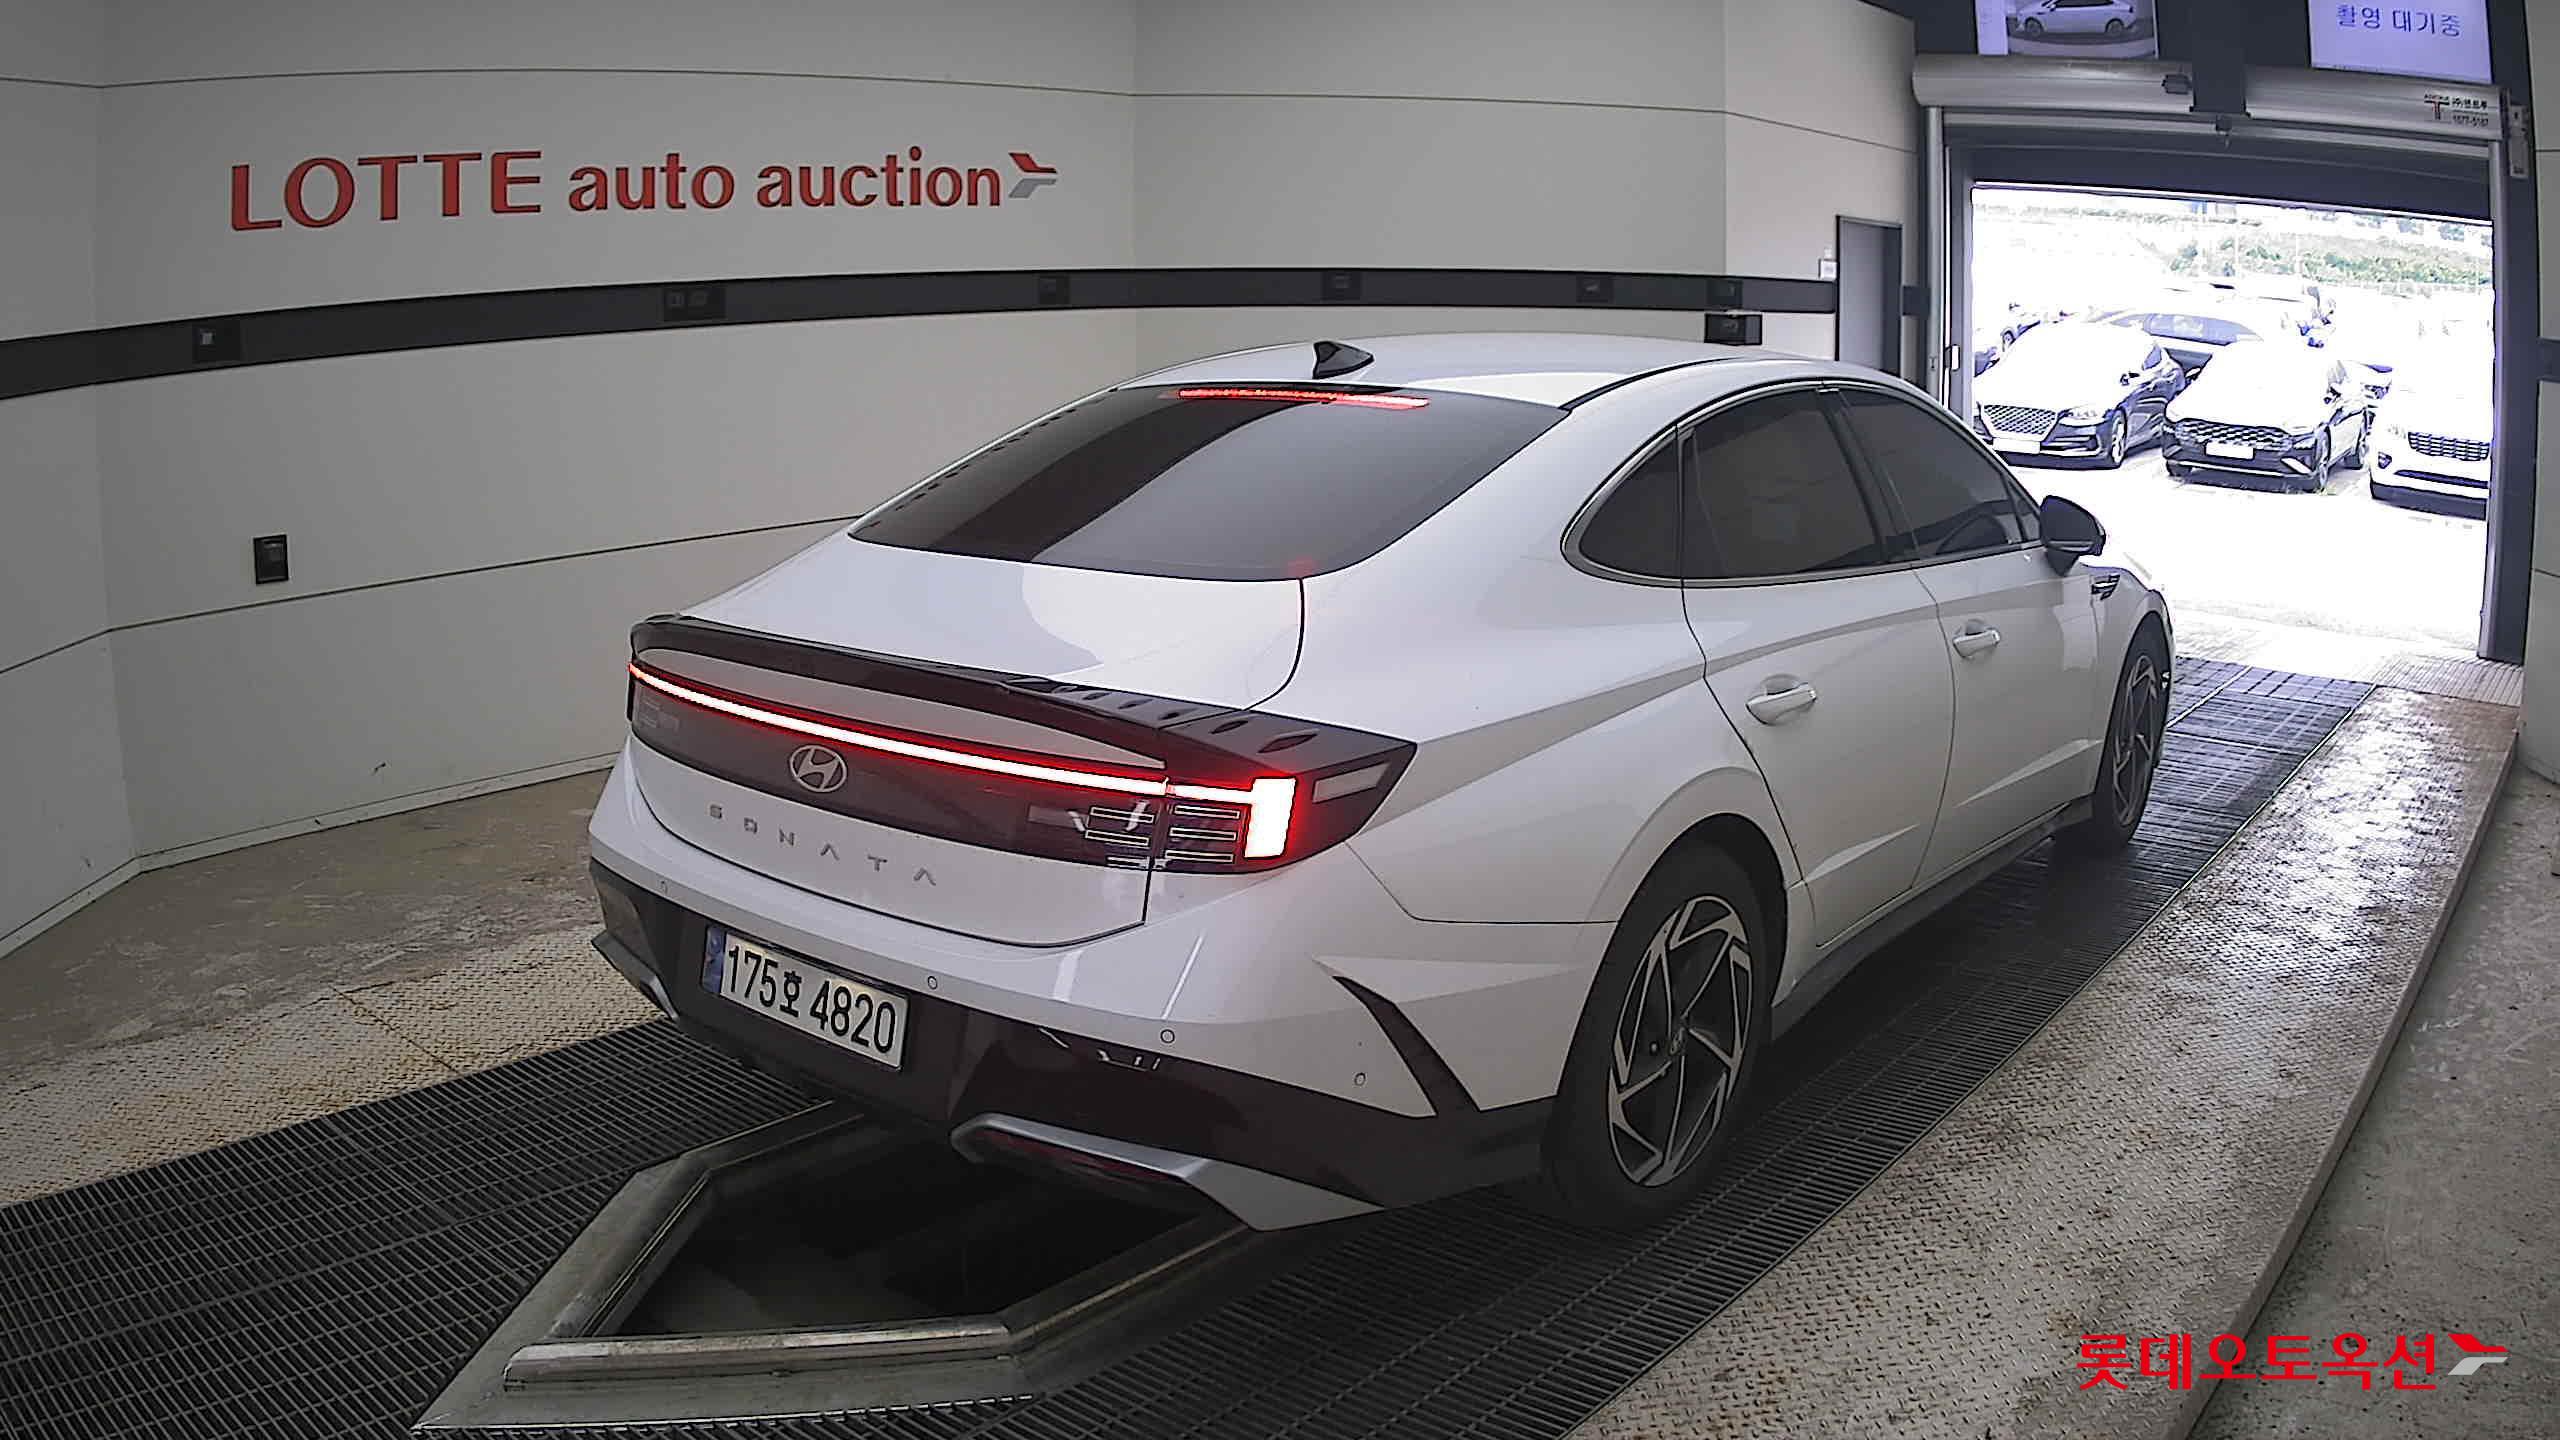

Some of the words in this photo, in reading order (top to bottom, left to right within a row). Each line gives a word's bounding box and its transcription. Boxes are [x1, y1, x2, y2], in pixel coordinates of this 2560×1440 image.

[2337, 4, 2381, 30] 촬영
[2392, 9, 2461, 38] 대기중
[229, 149, 543, 232] LOTTE
[568, 151, 736, 211] auto
[755, 145, 1001, 209] auction
[709, 803, 937, 887] SONATA
[728, 945, 802, 1019] 175호
[809, 980, 897, 1054] 4820
